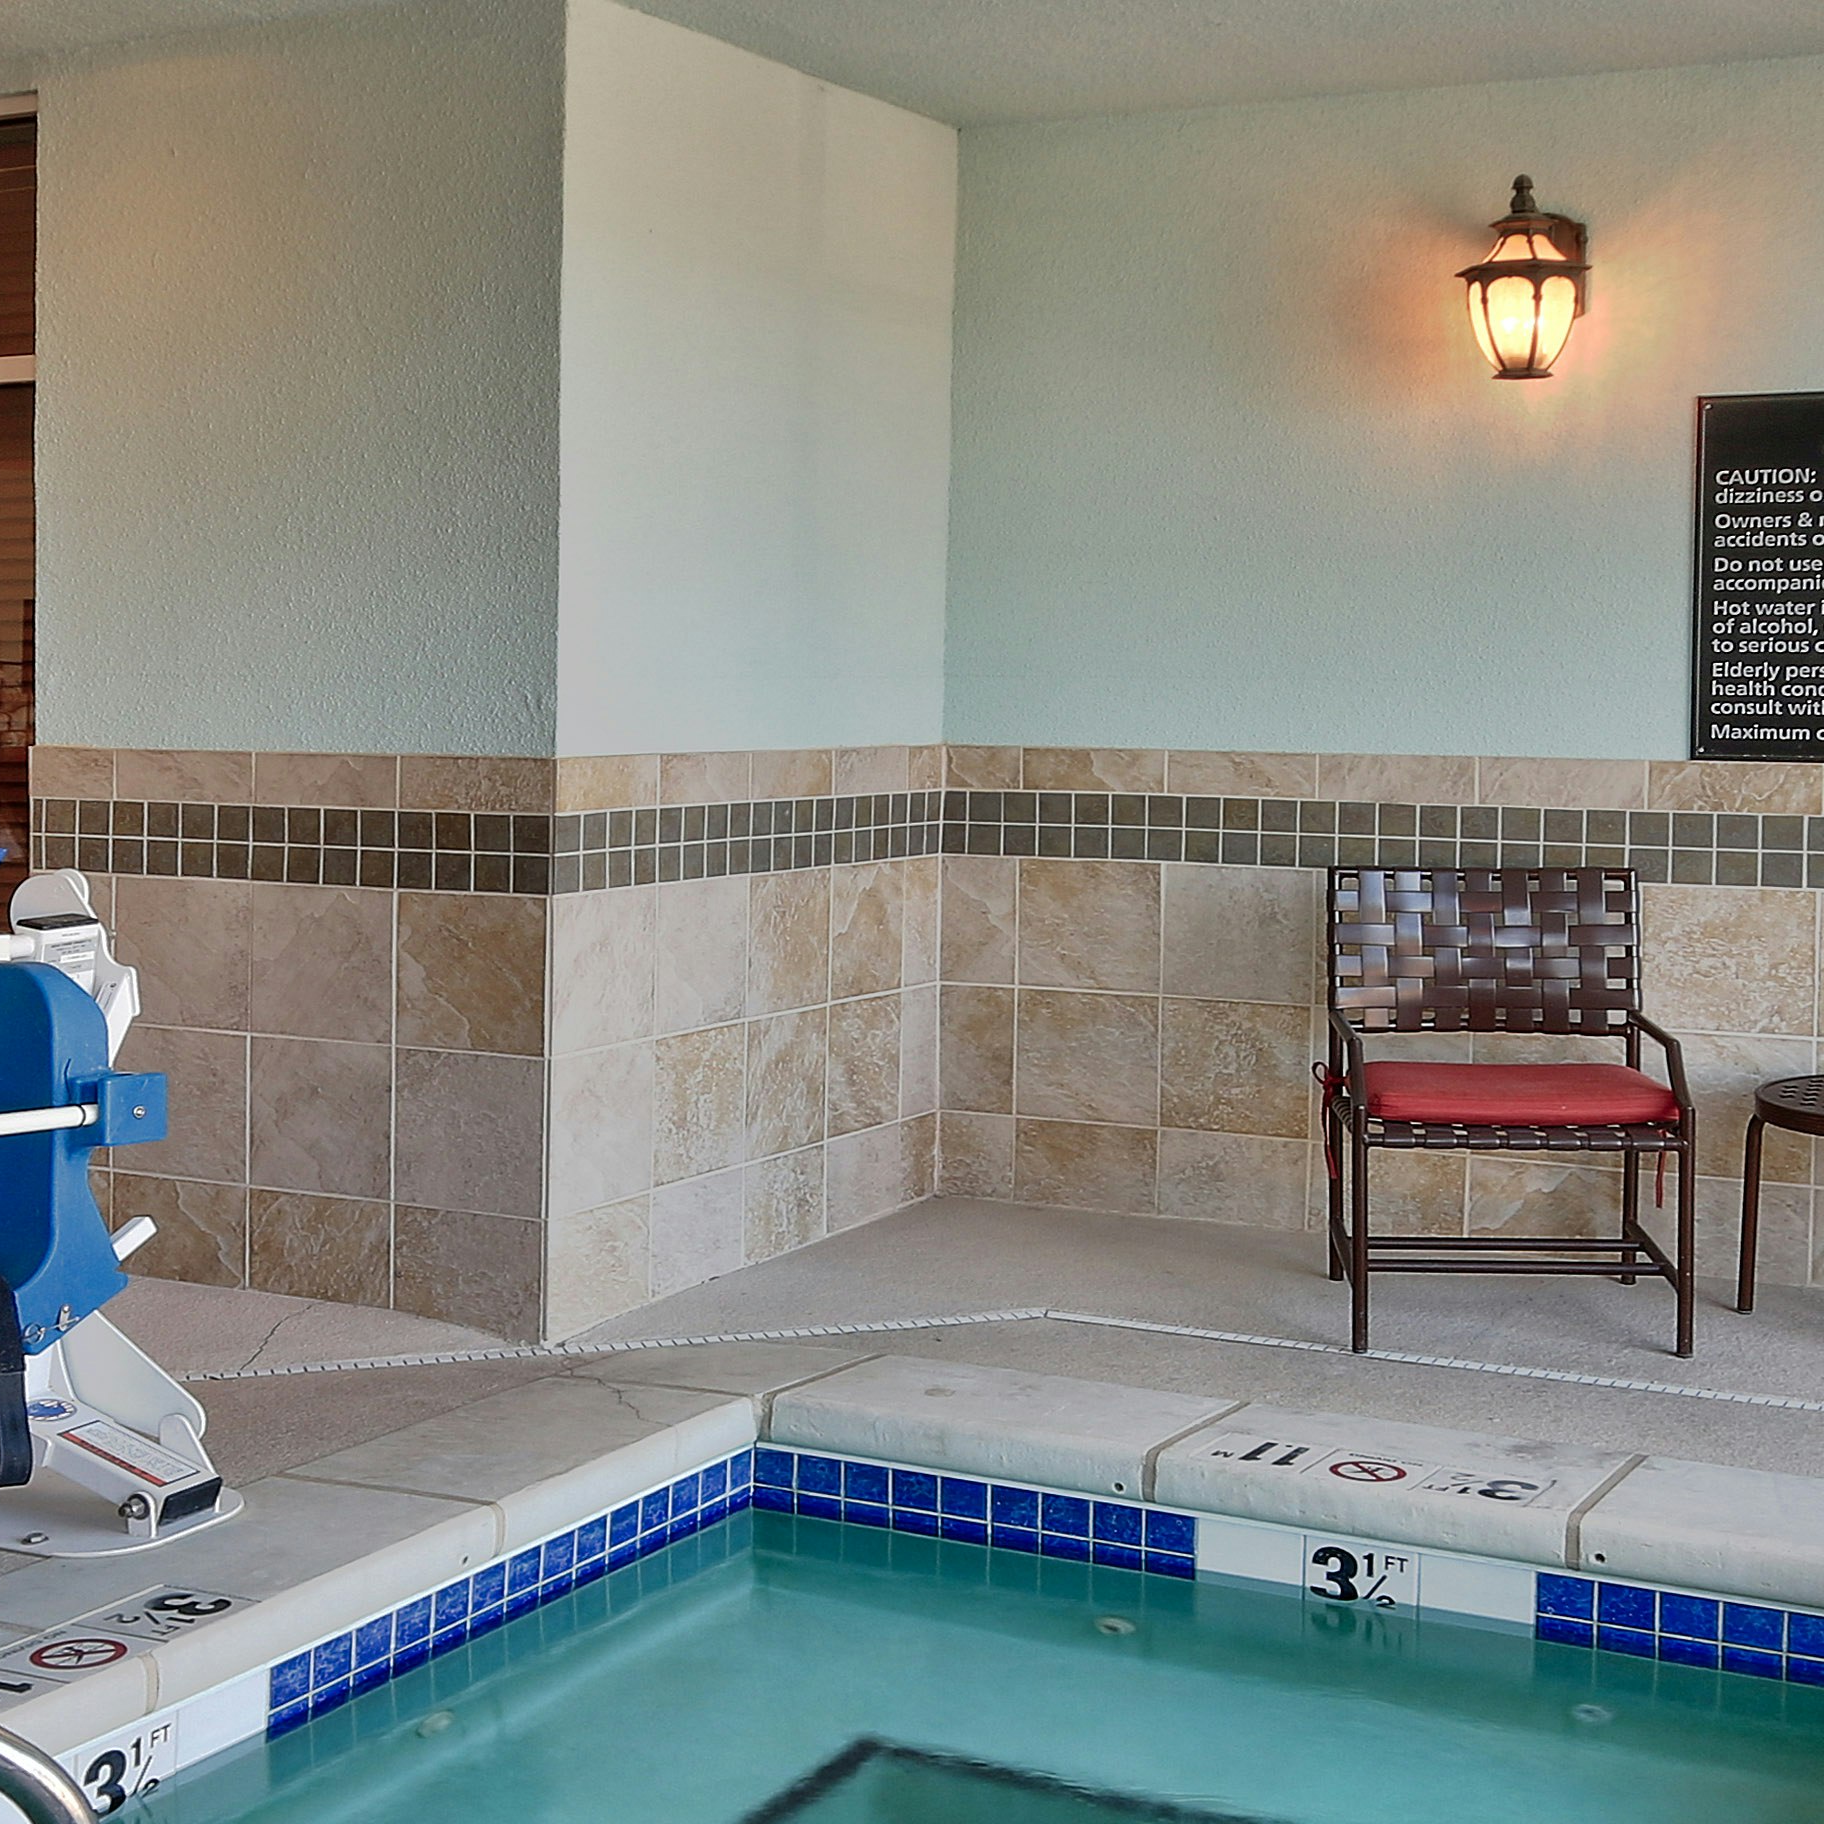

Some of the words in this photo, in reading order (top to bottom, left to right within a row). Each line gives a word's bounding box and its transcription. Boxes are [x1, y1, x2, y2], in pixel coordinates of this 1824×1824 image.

[1715, 467, 1817, 485] CAUTION:
[1715, 487, 1804, 505] dizziness
[1714, 511, 1792, 529] Owners
[1797, 512, 1813, 528] &
[1714, 530, 1807, 548] accidents
[1713, 557, 1743, 573] Do
[1748, 556, 1783, 572] not
[1789, 558, 1823, 572] use
[1713, 600, 1751, 616] Hot
[1755, 602, 1816, 616] water
[1712, 618, 1737, 635] of
[1739, 618, 1819, 636] alcohol,
[1712, 638, 1733, 653] to
[1738, 636, 1809, 653] serious
[1711, 662, 1780, 681] Elderly
[1711, 680, 1775, 697] health
[1710, 699, 1783, 716] consult
[1711, 724, 1811, 741] Maximum
[1384, 1555, 1409, 1574] FT
[150, 1723, 172, 1749] FT
